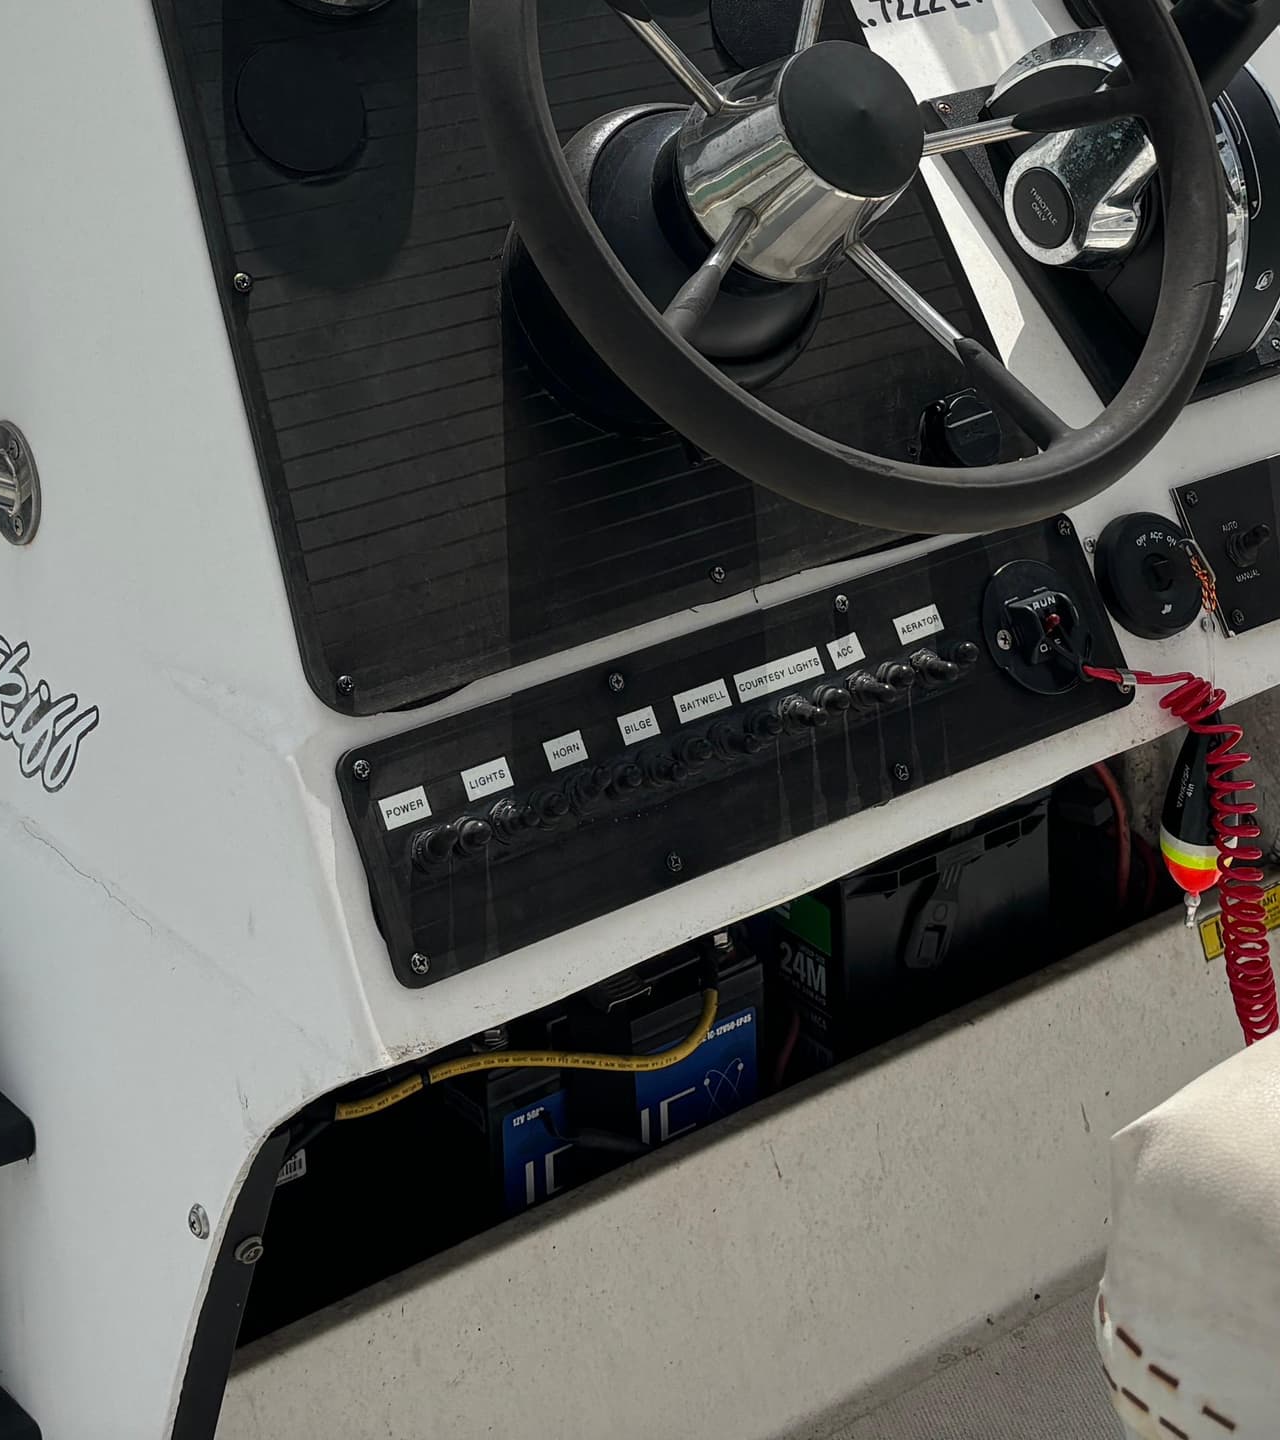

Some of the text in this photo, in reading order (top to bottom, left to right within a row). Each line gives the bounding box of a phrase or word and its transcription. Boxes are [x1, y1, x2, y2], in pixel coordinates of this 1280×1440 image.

[1030, 187, 1058, 226] THROTTLE
[1222, 521, 1238, 532] AUTO
[1236, 569, 1260, 583] MANUAL
[1032, 596, 1056, 610] RUN
[901, 615, 939, 635] AERATOR
[836, 646, 853, 658] ACC
[739, 657, 820, 692] COURTESY LIGHTS
[680, 690, 726, 712] BAITWELL
[624, 718, 652, 735] BILGE
[552, 742, 580, 760] HORN
[470, 769, 506, 790] LIGHTS
[386, 799, 424, 819] POWER
[779, 940, 827, 998] 24M
